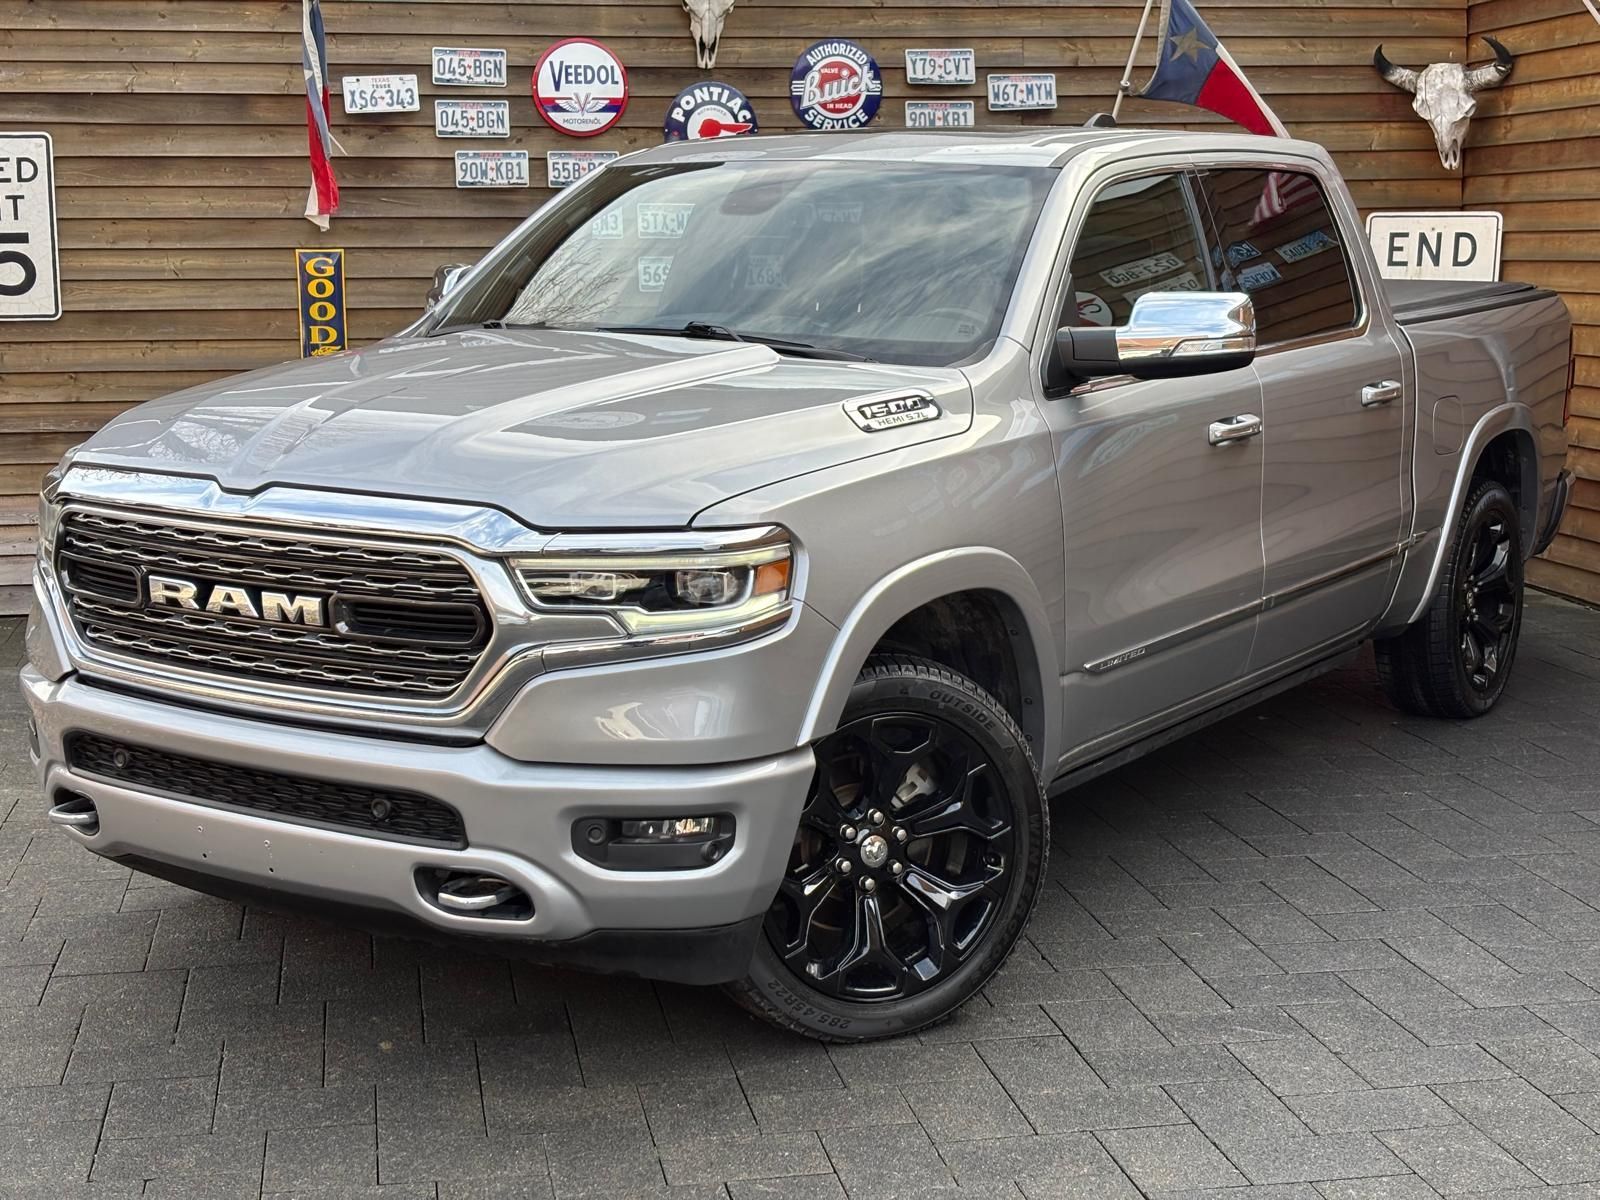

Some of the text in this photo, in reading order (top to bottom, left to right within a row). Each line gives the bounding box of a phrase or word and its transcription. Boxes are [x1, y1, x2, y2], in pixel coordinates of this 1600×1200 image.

[806, 43, 868, 66] AUTHORIZED
[436, 57, 502, 78] 045 BGN
[549, 60, 619, 92] VEEDOL
[909, 57, 971, 76] Y79 CVT
[800, 62, 875, 110] Buick
[992, 83, 1019, 102] W67
[348, 87, 415, 109] XS6 343
[671, 86, 752, 123] PONTIAC
[440, 109, 505, 129] 045 BGN
[804, 109, 869, 131] SERVICE
[495, 161, 525, 180] KB1
[552, 162, 580, 180] 55B
[1386, 231, 1478, 267] END
[305, 256, 338, 344] GOOD
[876, 414, 906, 427] HEMI
[148, 575, 324, 626] RAM
[929, 689, 996, 731] OUTSIDE
